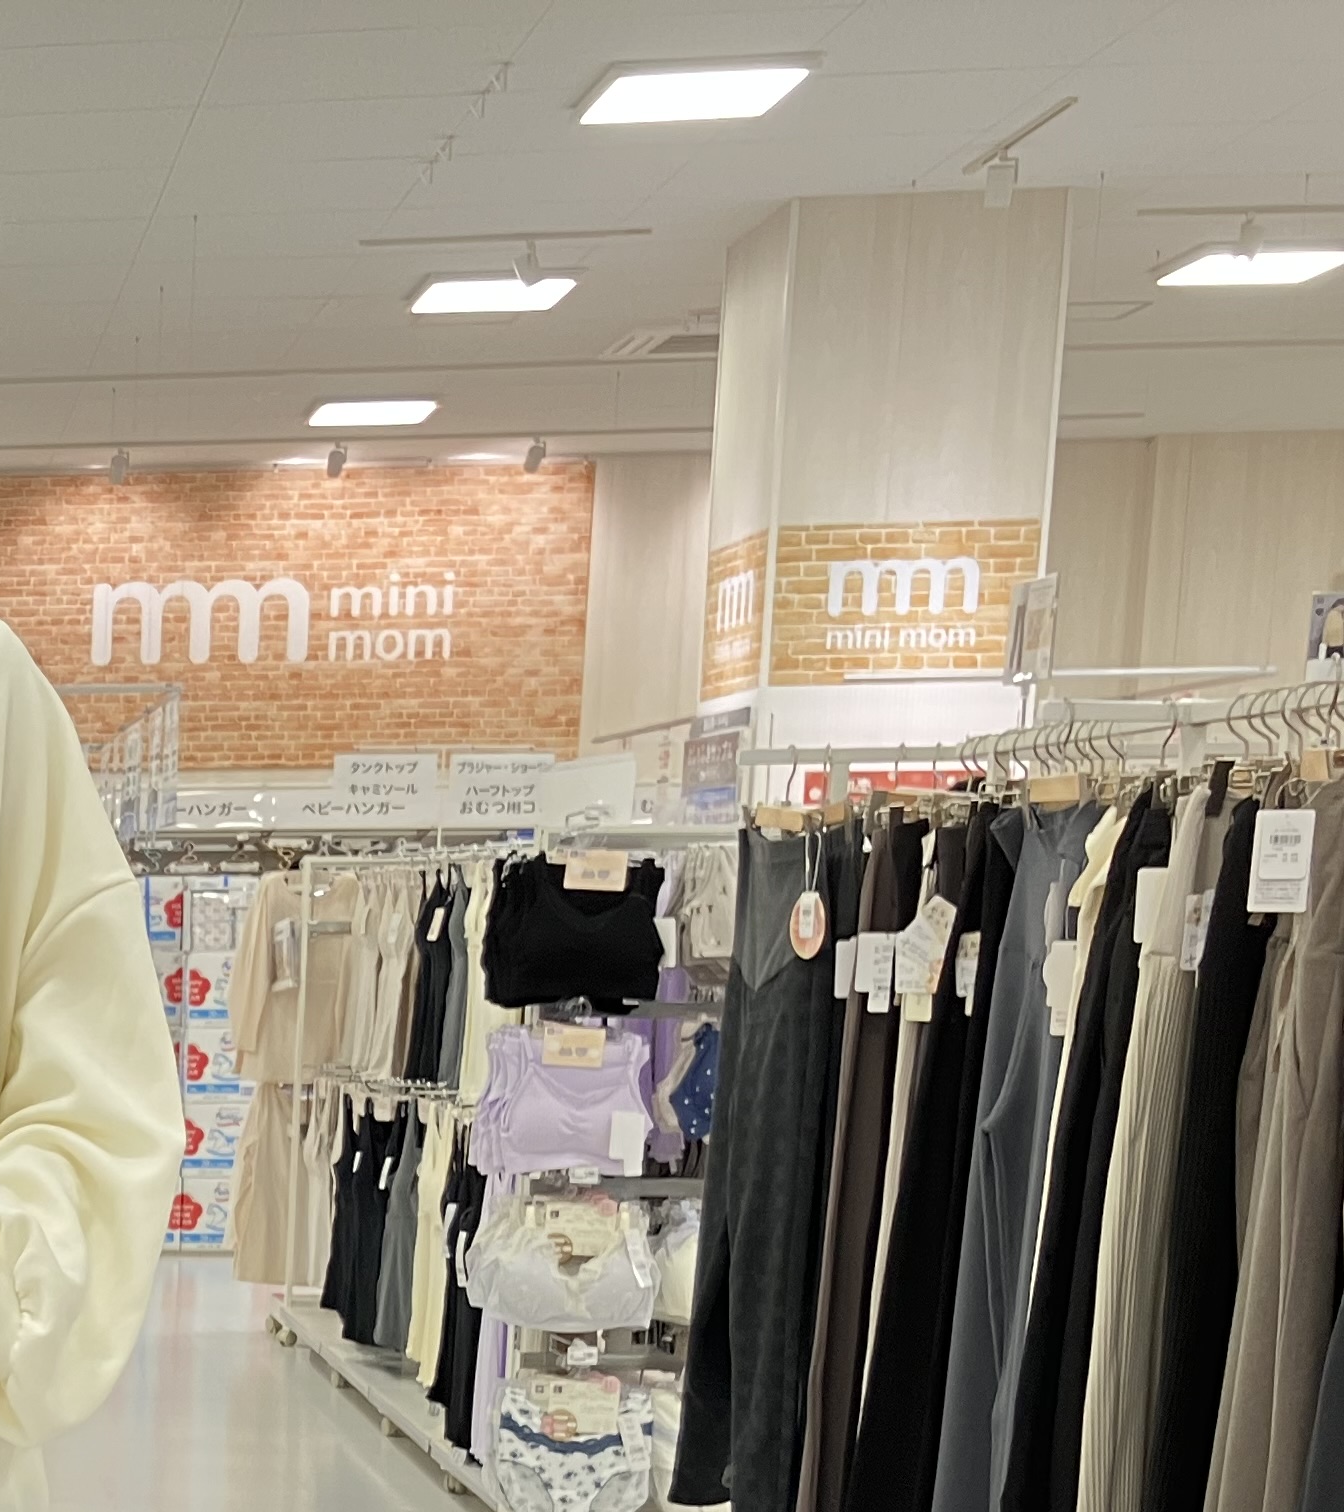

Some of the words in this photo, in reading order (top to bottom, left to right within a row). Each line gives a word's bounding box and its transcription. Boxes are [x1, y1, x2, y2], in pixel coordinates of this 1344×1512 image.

[330, 572, 456, 618] mini
[826, 623, 891, 650] mini
[899, 624, 977, 648] mom
[328, 628, 453, 661] mom
[350, 761, 419, 775] タンクトップ
[348, 783, 418, 796] キャミソール
[465, 783, 535, 797] ハーフトップ
[302, 801, 405, 816] ベビーハンガー
